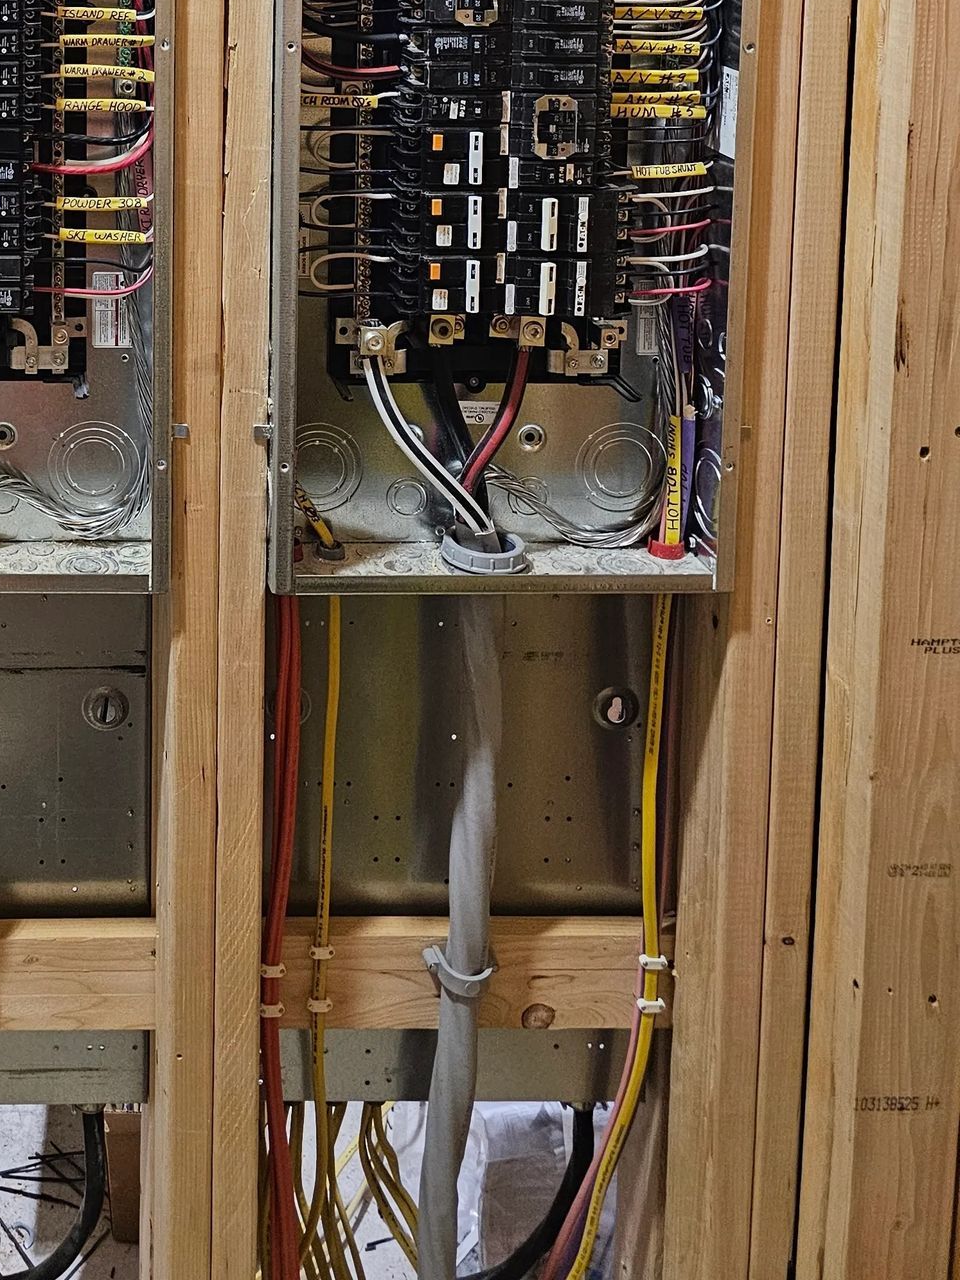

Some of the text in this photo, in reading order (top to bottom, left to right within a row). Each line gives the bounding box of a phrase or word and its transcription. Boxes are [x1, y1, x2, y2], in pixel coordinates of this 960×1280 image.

[61, 9, 104, 19] ISLAND
[63, 38, 88, 46] WARM
[91, 38, 127, 46] DRAWER
[64, 66, 89, 76] WARM
[91, 67, 126, 77] DRAWER
[613, 72, 651, 84] A/V
[64, 101, 141, 111] RANGE HOOD
[635, 164, 697, 177] HOT TUB SHUNT
[135, 159, 148, 196] DRYER
[61, 199, 142, 209] POWDER 308
[66, 230, 142, 242] SKI WASHER
[666, 422, 679, 530] HOT TUB SHUNT
[911, 638, 960, 646] HAMPT
[924, 647, 960, 655] PLUS
